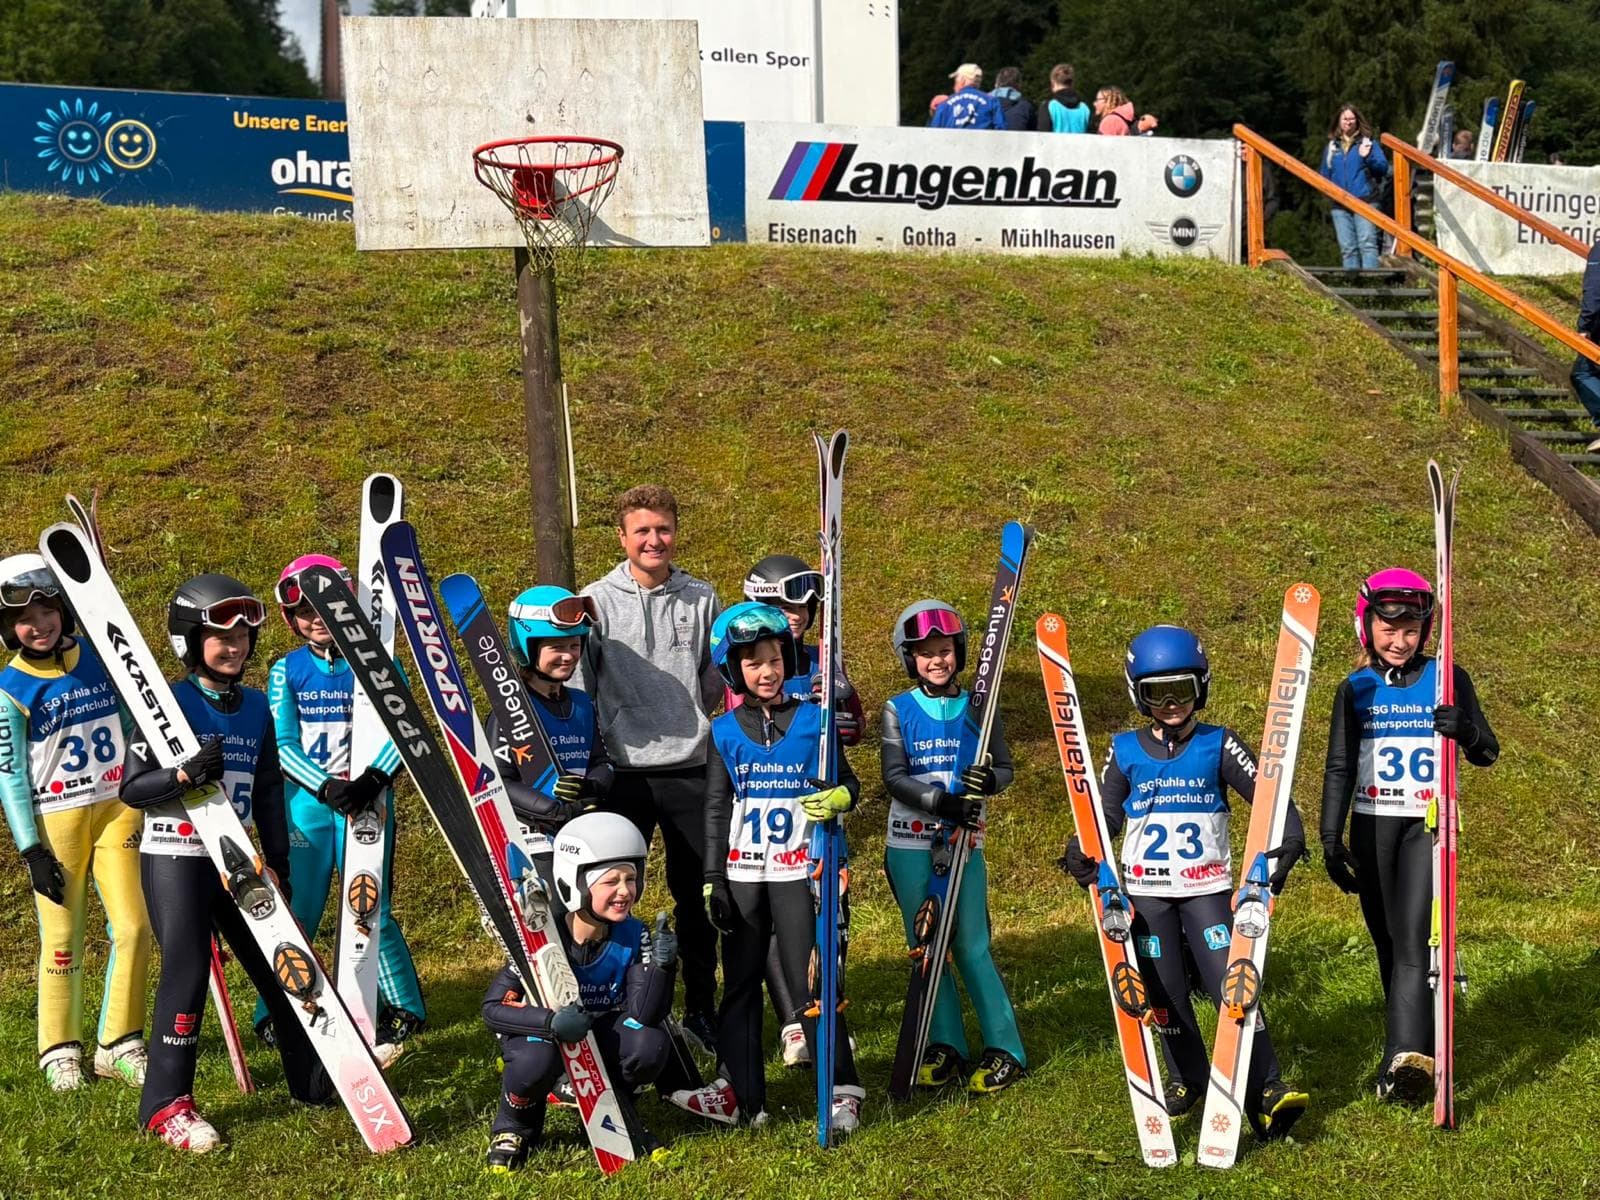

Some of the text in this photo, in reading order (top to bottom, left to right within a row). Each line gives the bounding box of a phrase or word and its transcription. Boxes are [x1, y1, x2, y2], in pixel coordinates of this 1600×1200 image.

[711, 47, 758, 64] allen
[233, 111, 348, 132] Unsere Ener
[271, 150, 352, 188] ohra
[816, 144, 1122, 210] Langenhan
[1491, 184, 1600, 219] Thüringe
[768, 223, 856, 245] Eisenach
[903, 226, 956, 247] Gotha
[1001, 228, 1115, 250] Mühlhausen
[1172, 227, 1196, 238] MINI
[753, 585, 778, 594] uvex
[394, 556, 467, 713] SPORTEN
[972, 604, 1005, 707] fluege.de
[61, 687, 91, 701] Ruhla
[327, 600, 432, 758] SPORTEN
[478, 635, 534, 741] fluege.de
[296, 690, 348, 701] TSG Ruhla
[1391, 704, 1423, 714] Ruhla
[1261, 667, 1307, 779] stanley
[58, 726, 116, 773] 38
[913, 740, 933, 751] TSG
[1054, 691, 1090, 794] stanley
[752, 762, 784, 773] Ruhla
[786, 763, 805, 774] e.V.
[1377, 746, 1435, 783] 36
[474, 785, 503, 804] SPORTEN
[1155, 776, 1186, 788] Ruhla
[1188, 777, 1206, 788] e.V.
[1203, 793, 1215, 804] 07
[744, 807, 794, 845] 19
[1142, 822, 1204, 861] 23
[560, 842, 581, 856] uvex
[355, 1084, 394, 1135] SJX
